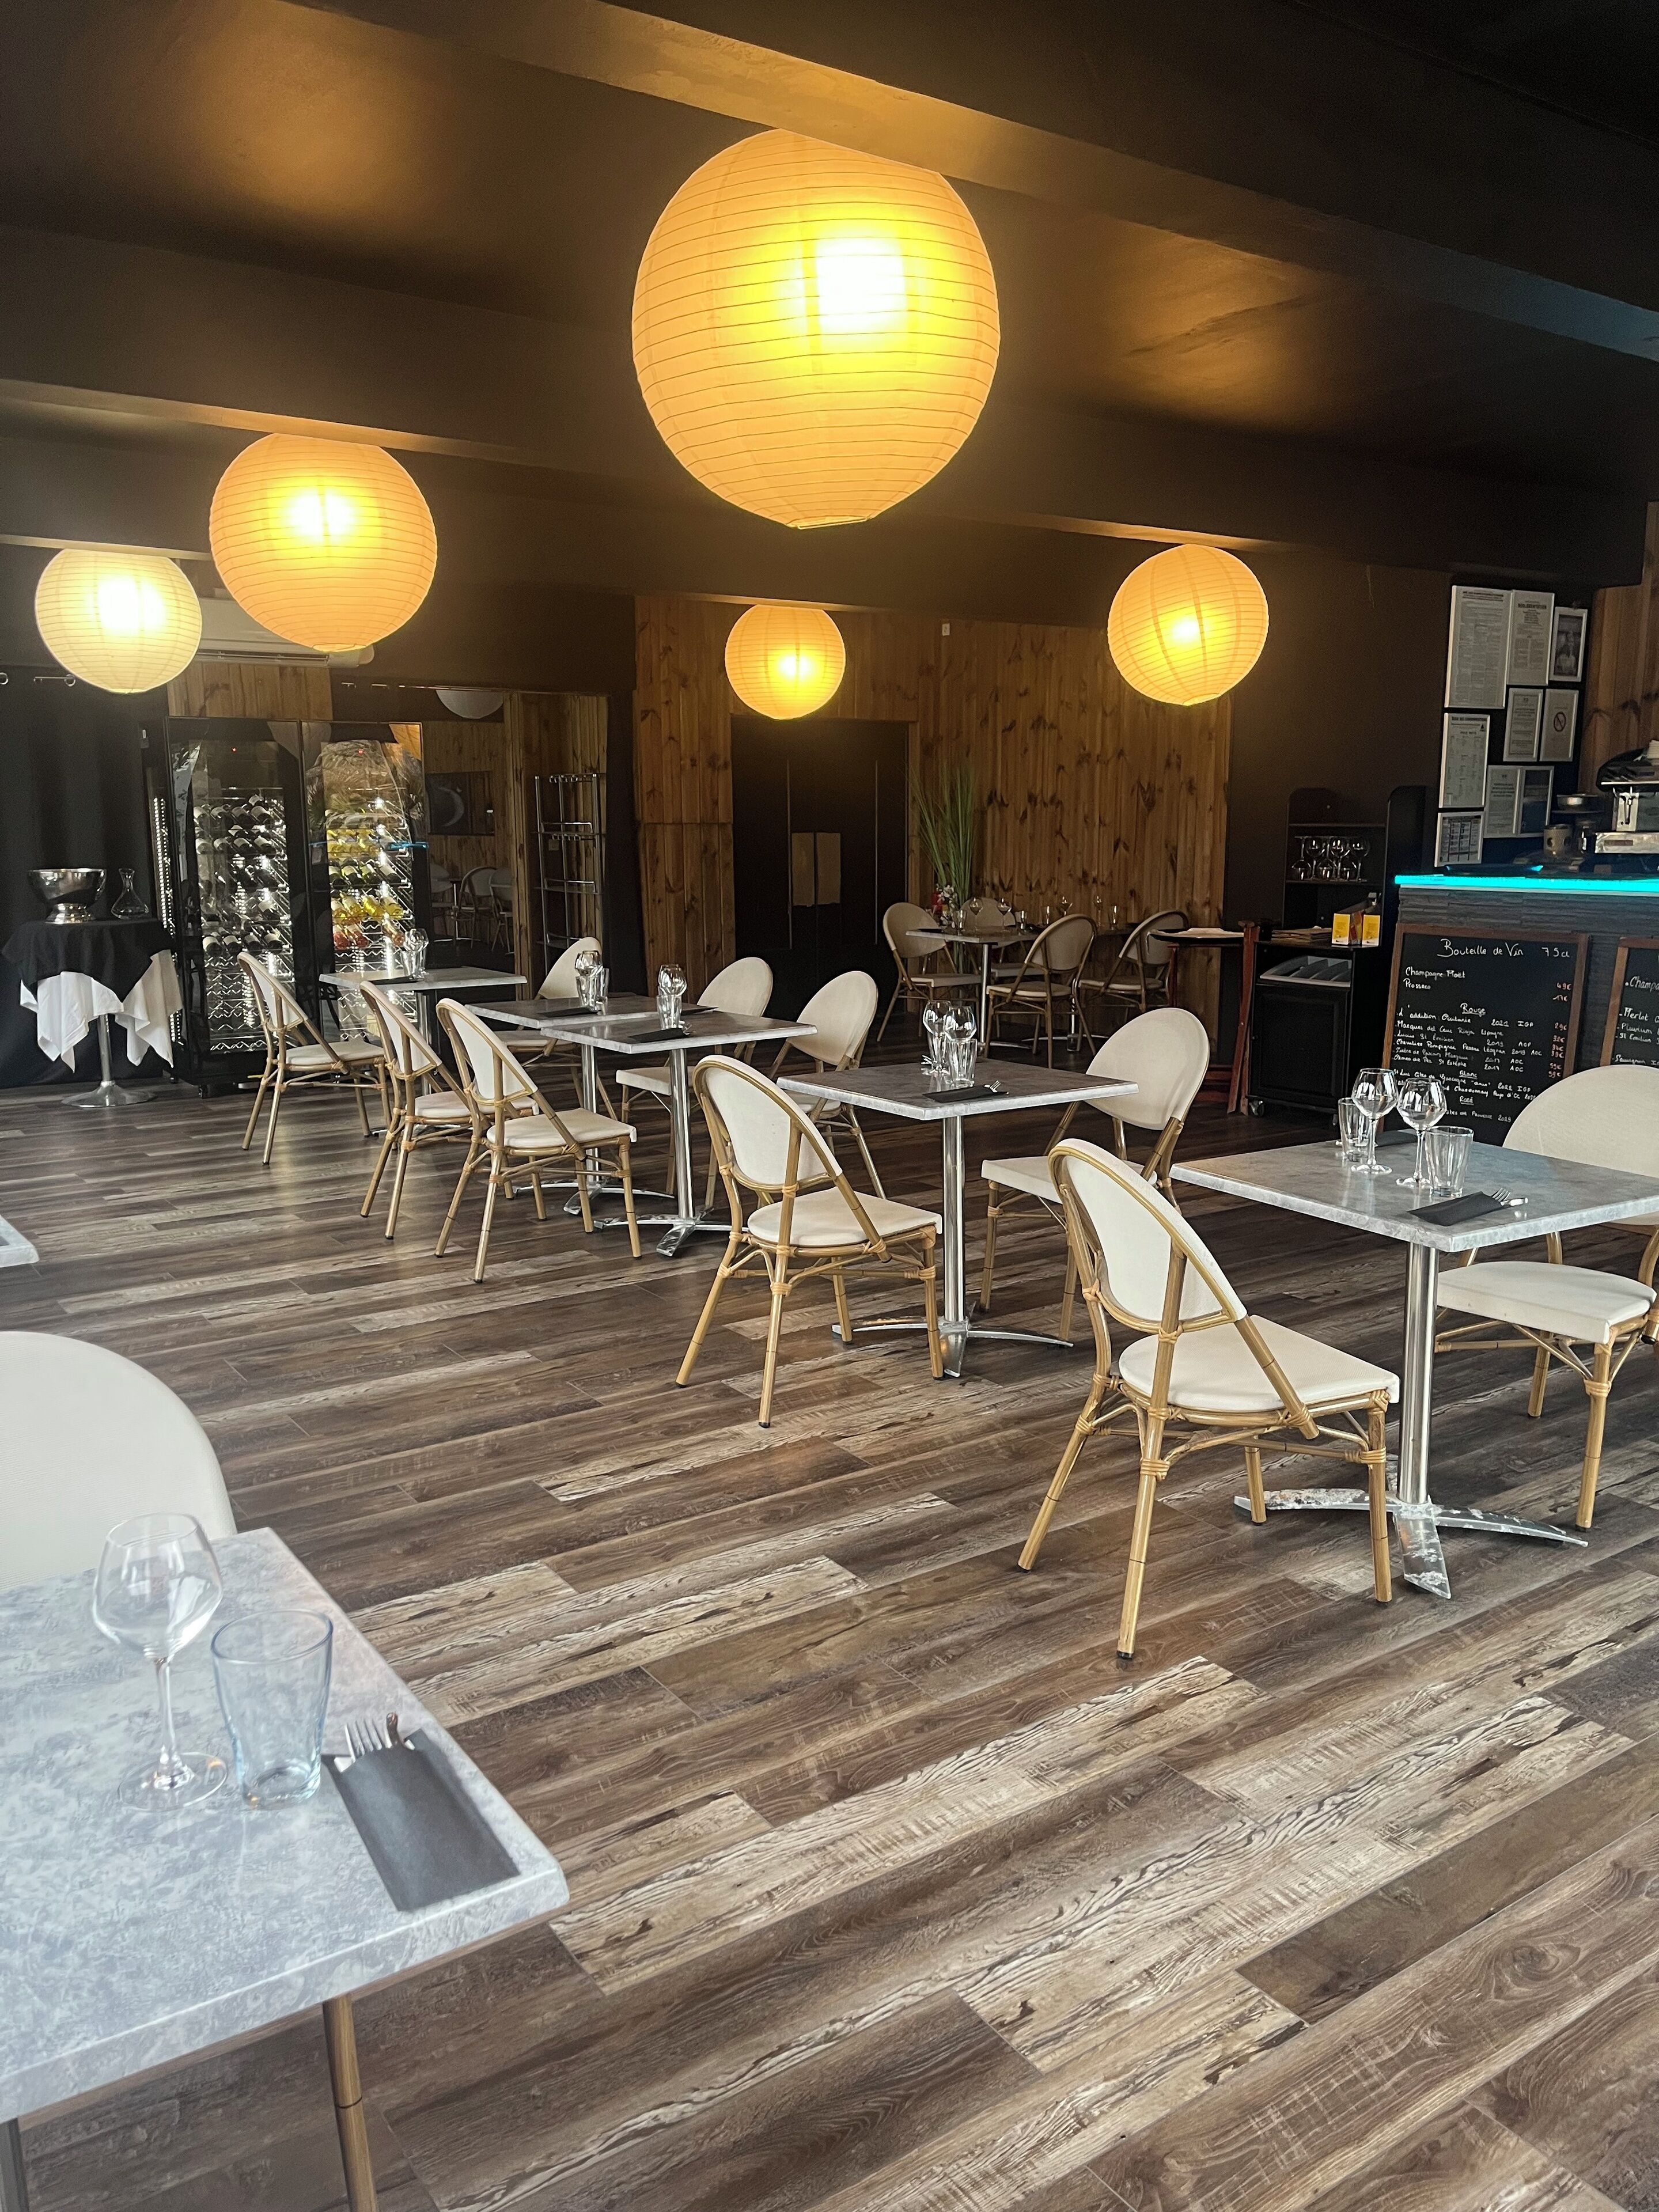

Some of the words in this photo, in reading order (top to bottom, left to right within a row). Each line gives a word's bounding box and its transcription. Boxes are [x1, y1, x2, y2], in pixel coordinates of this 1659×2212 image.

[1437, 938, 1487, 957] Bouteille
[1493, 947, 1503, 955] de
[1505, 942, 1524, 957] Vin
[1406, 966, 1443, 981] Champagne
[1460, 1002, 1486, 1018] Rouge
[1624, 1007, 1648, 1021] Merlot
[1554, 1022, 1567, 1031] 29€
[1459, 1070, 1478, 1079] Blanc
